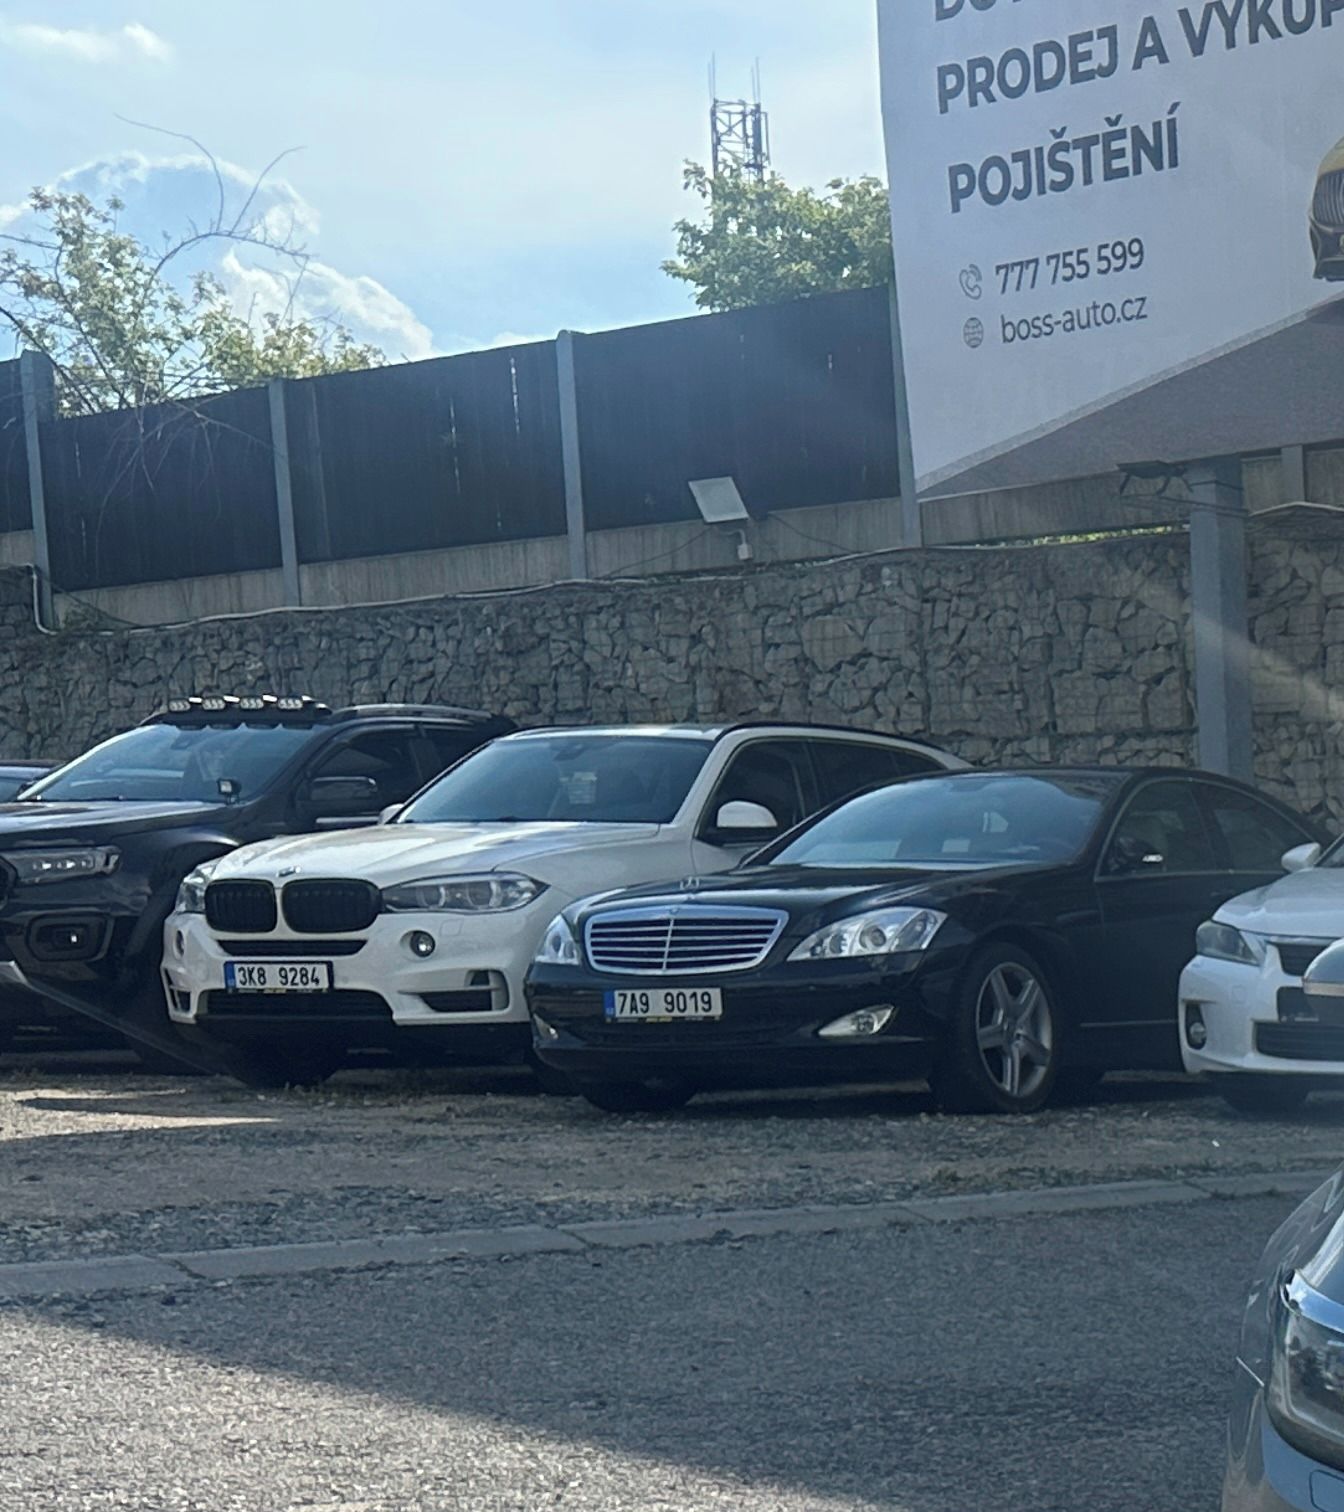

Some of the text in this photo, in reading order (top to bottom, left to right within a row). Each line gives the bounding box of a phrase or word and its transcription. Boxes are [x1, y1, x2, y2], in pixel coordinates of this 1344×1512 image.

[936, 24, 1119, 115] PRODEJ
[1131, 15, 1170, 71] A
[947, 101, 1181, 214] POJIŠTĚNÍ
[995, 237, 1145, 295] 777 755 599
[1000, 296, 1148, 344] boss-auto.cz
[238, 966, 320, 987] 3K8 9284
[618, 991, 712, 1015] 7A9 9019
